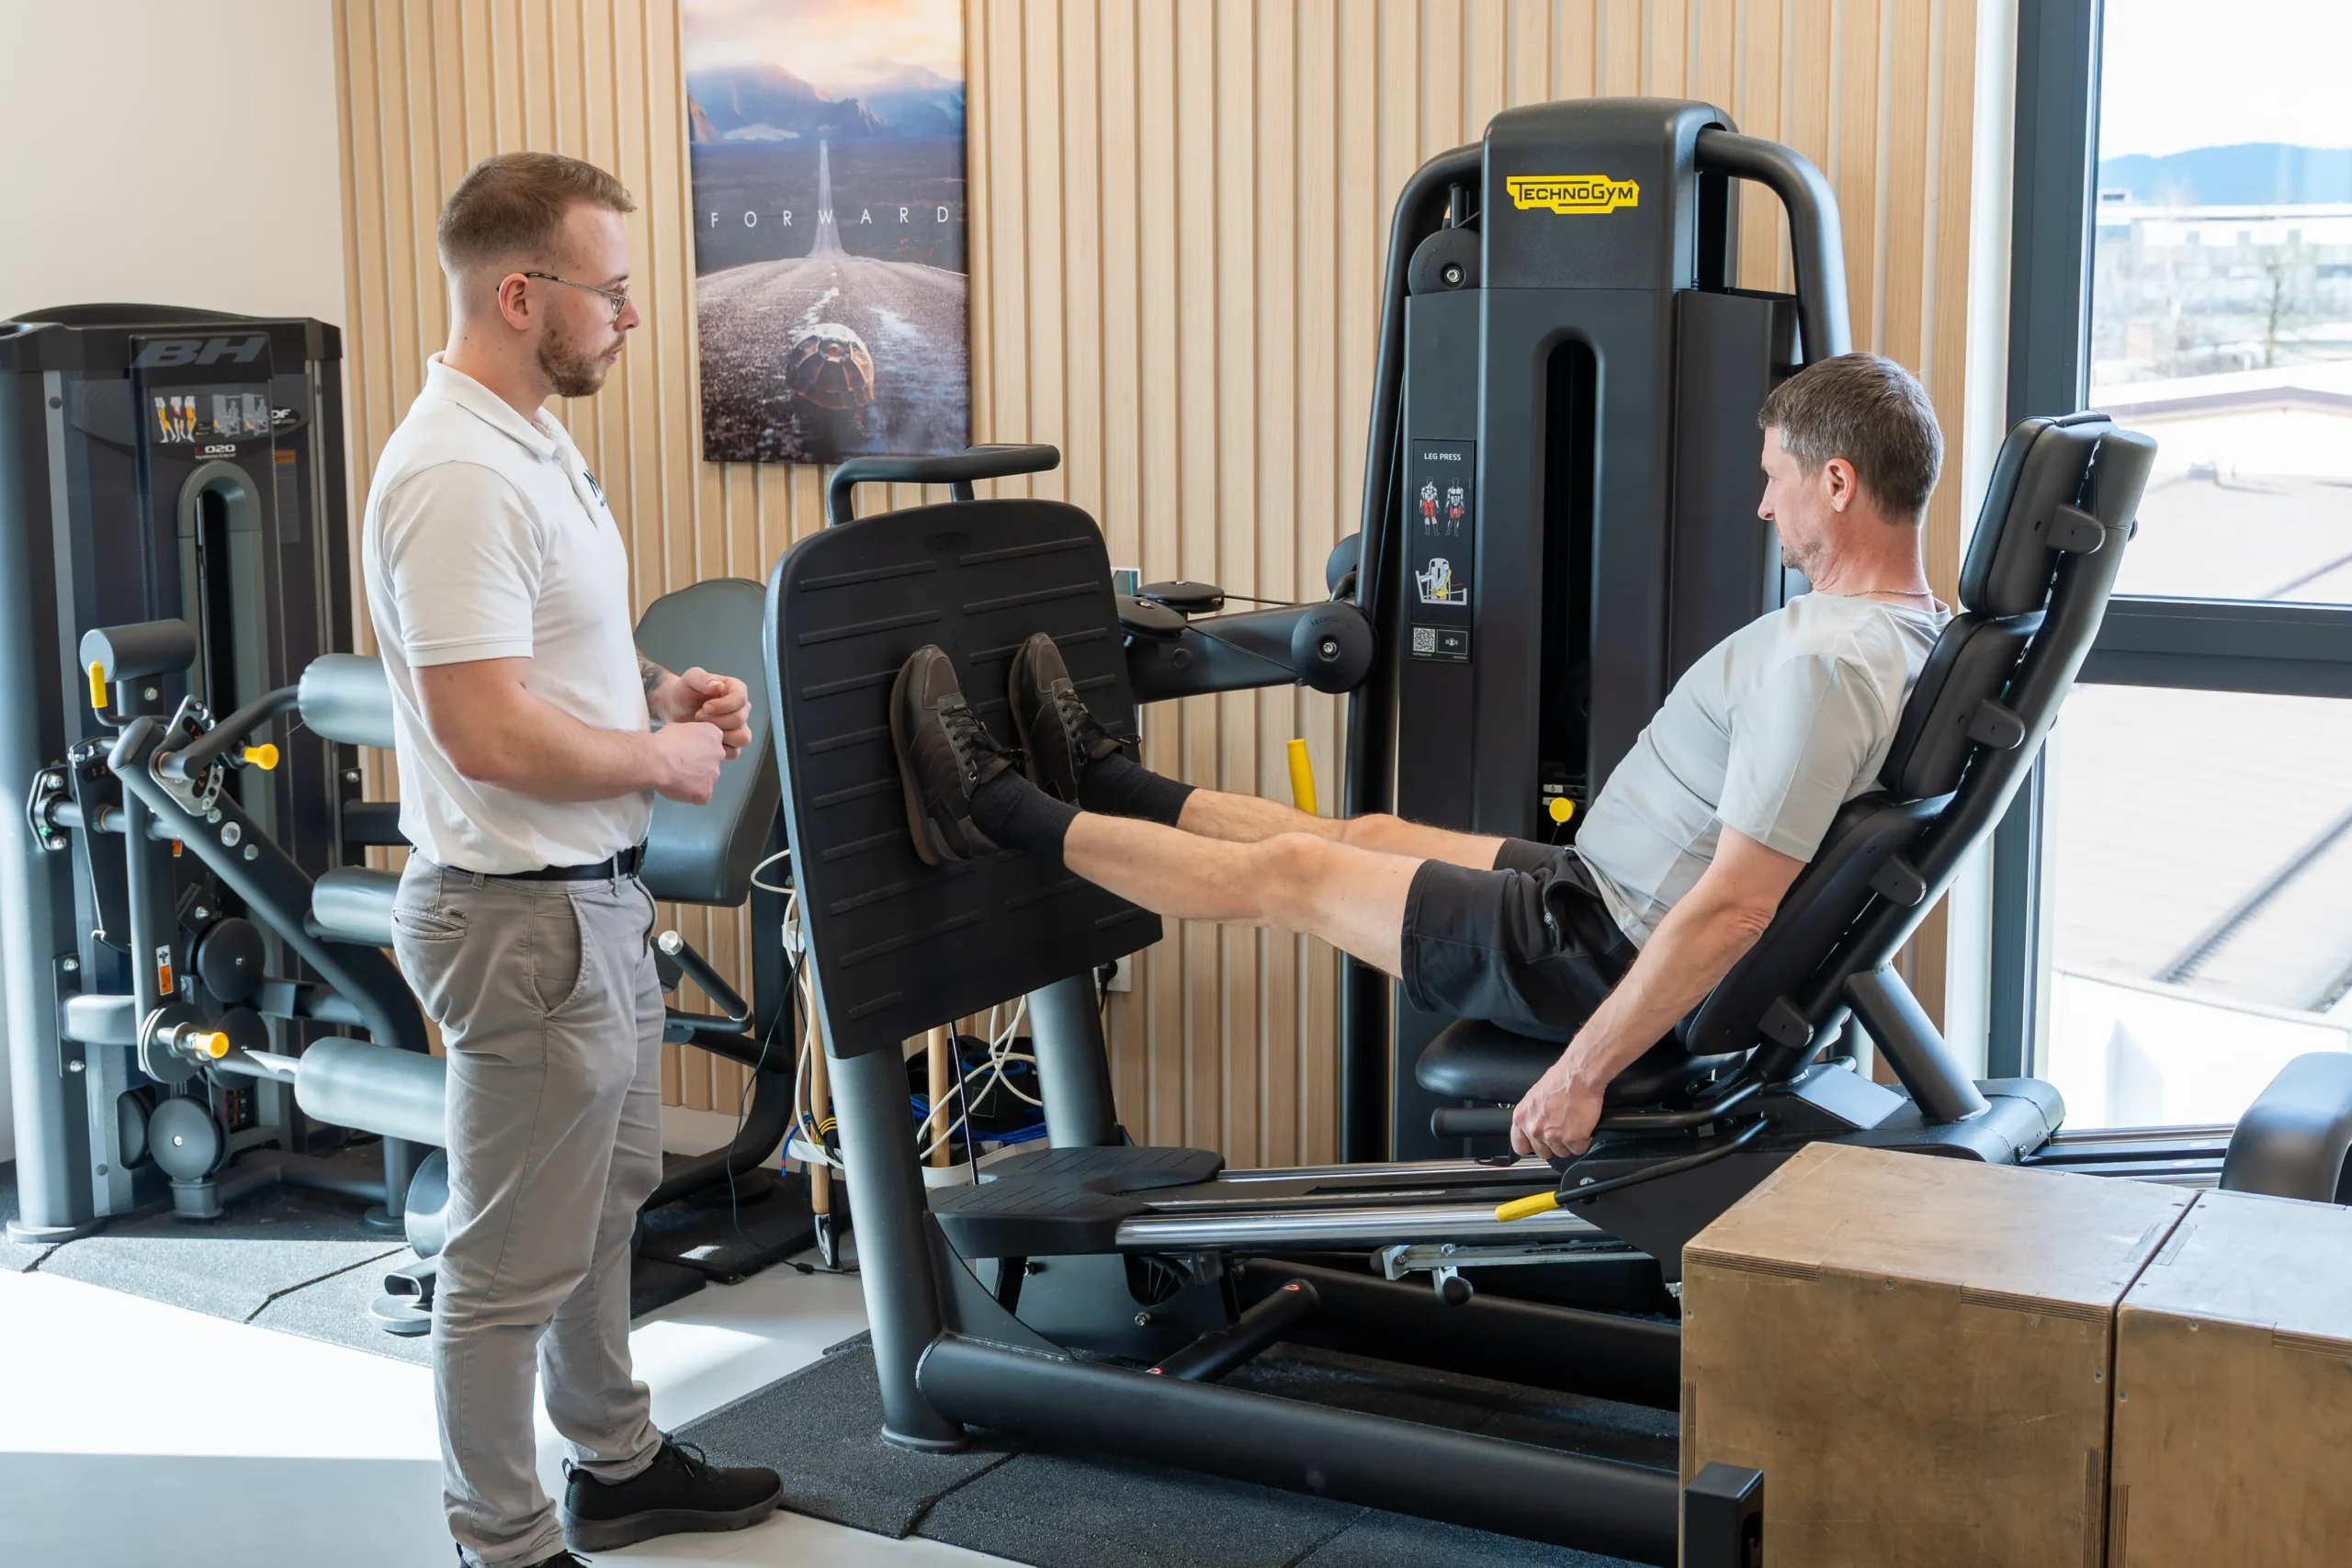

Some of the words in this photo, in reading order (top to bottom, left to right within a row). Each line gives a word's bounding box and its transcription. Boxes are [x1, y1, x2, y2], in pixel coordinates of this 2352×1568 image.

[1510, 181, 1634, 207] TECHNOGYM
[711, 207, 949, 229] FORWARD
[130, 336, 267, 368] BH
[1439, 453, 1462, 461] PRESS
